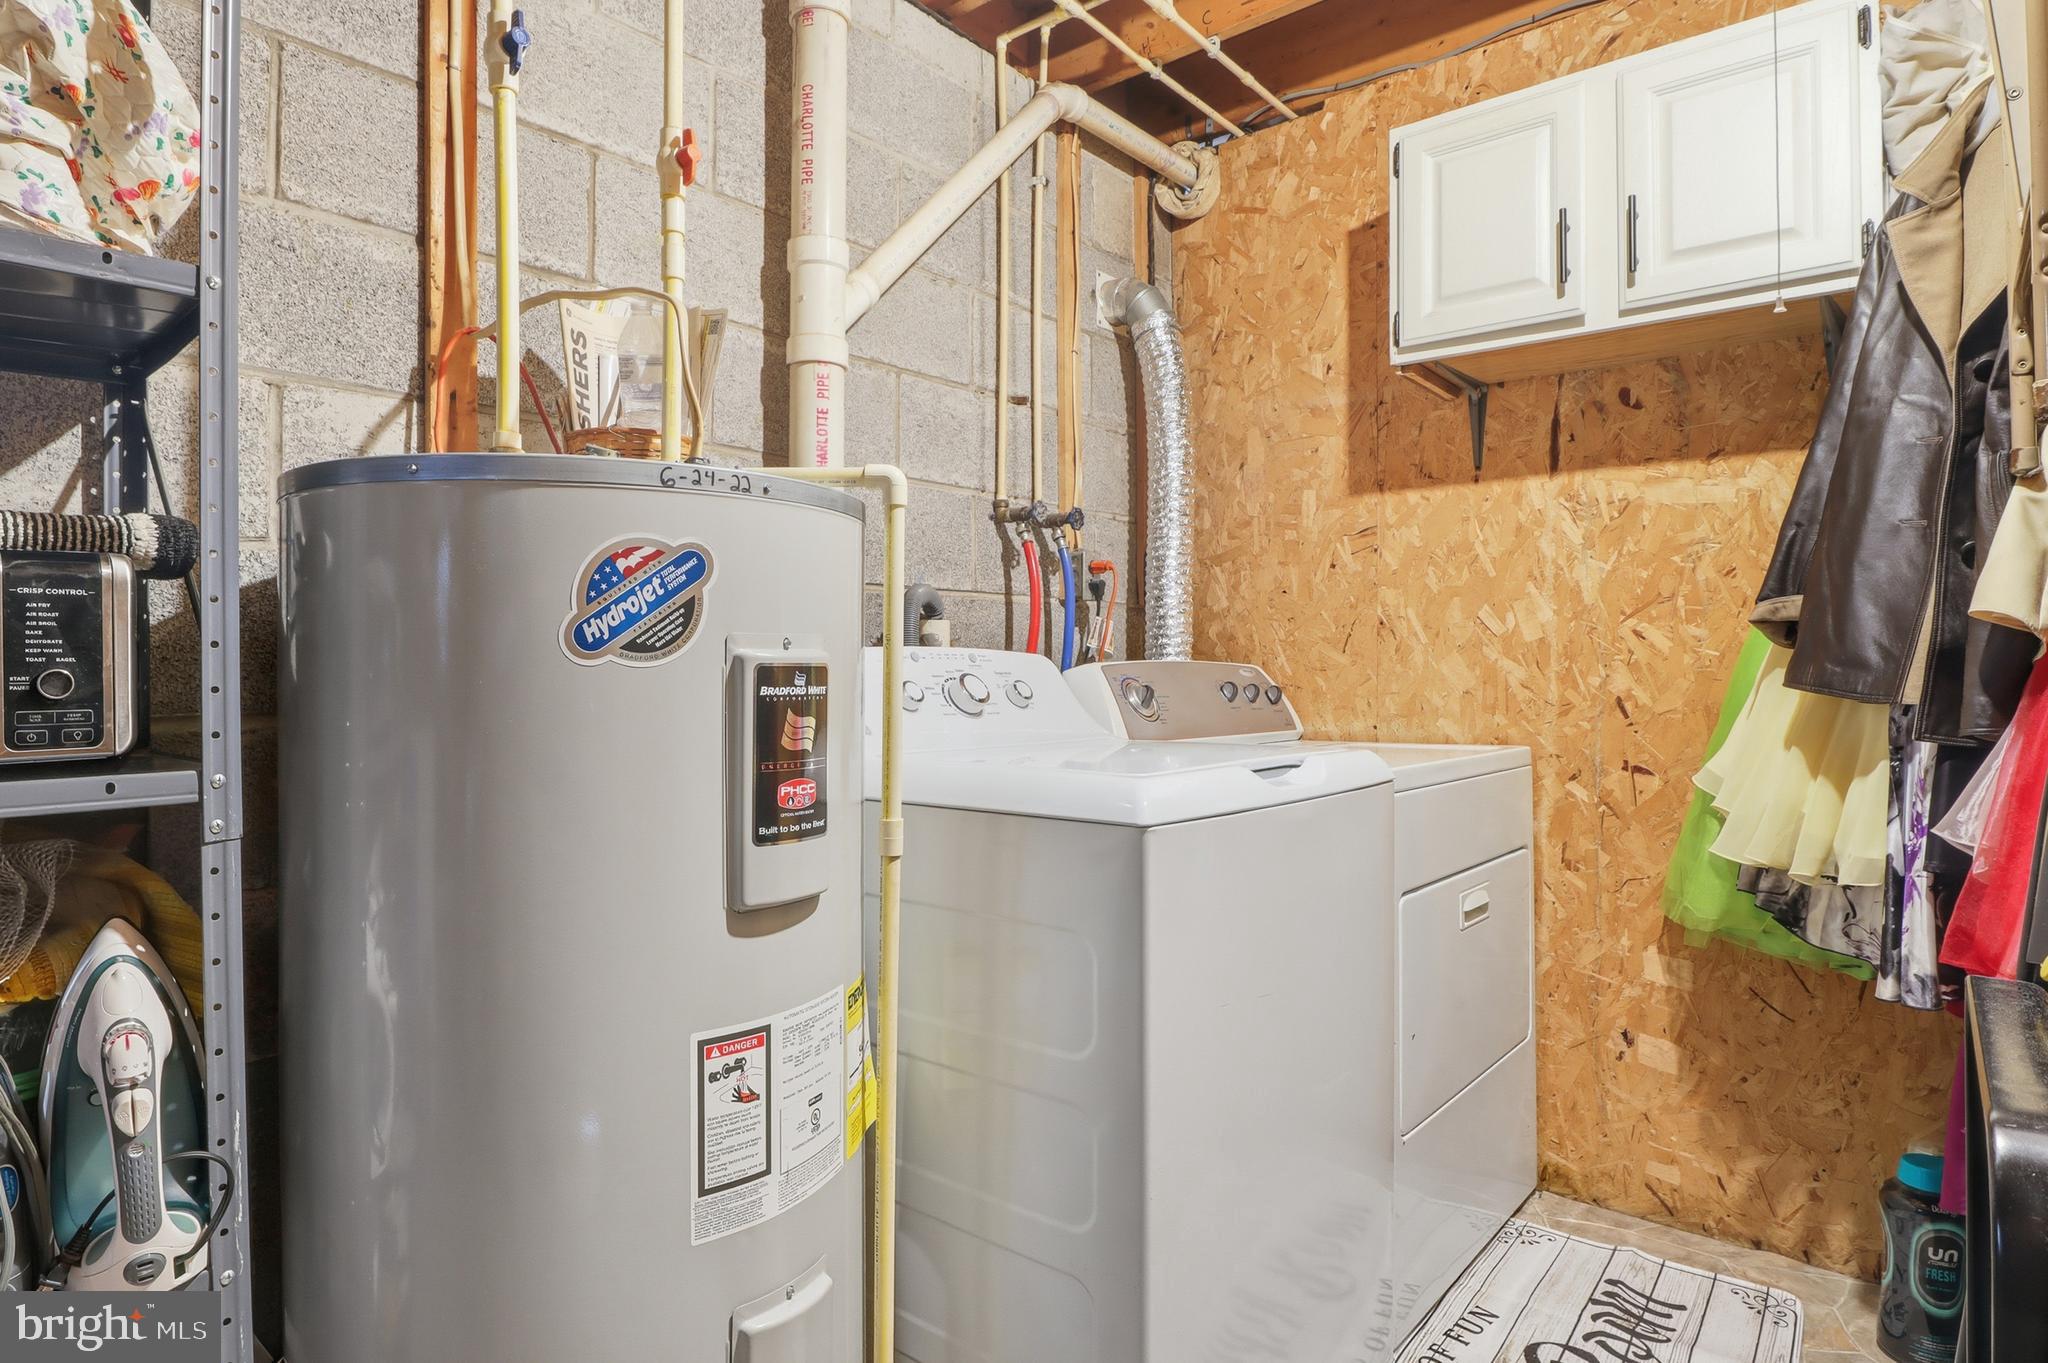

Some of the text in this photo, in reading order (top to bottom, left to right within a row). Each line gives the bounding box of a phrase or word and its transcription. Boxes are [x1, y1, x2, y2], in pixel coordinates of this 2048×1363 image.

[801, 84, 814, 151] CHARLOTTE
[801, 159, 814, 185] PIPE
[816, 372, 830, 467] HARLOTTE PIPE
[660, 466, 752, 494] 6-24-22
[45, 588, 88, 596] CONTROL
[581, 574, 665, 645] Hydrojet
[760, 685, 827, 696] BRADFORD WHITE
[780, 783, 816, 796] PHCC
[758, 826, 778, 836] Built
[790, 824, 800, 832] be
[801, 822, 812, 830] the
[722, 1038, 758, 1054] DANGER
[1925, 1267, 1956, 1283] FRESH
[1442, 1305, 1500, 1346] FUN
